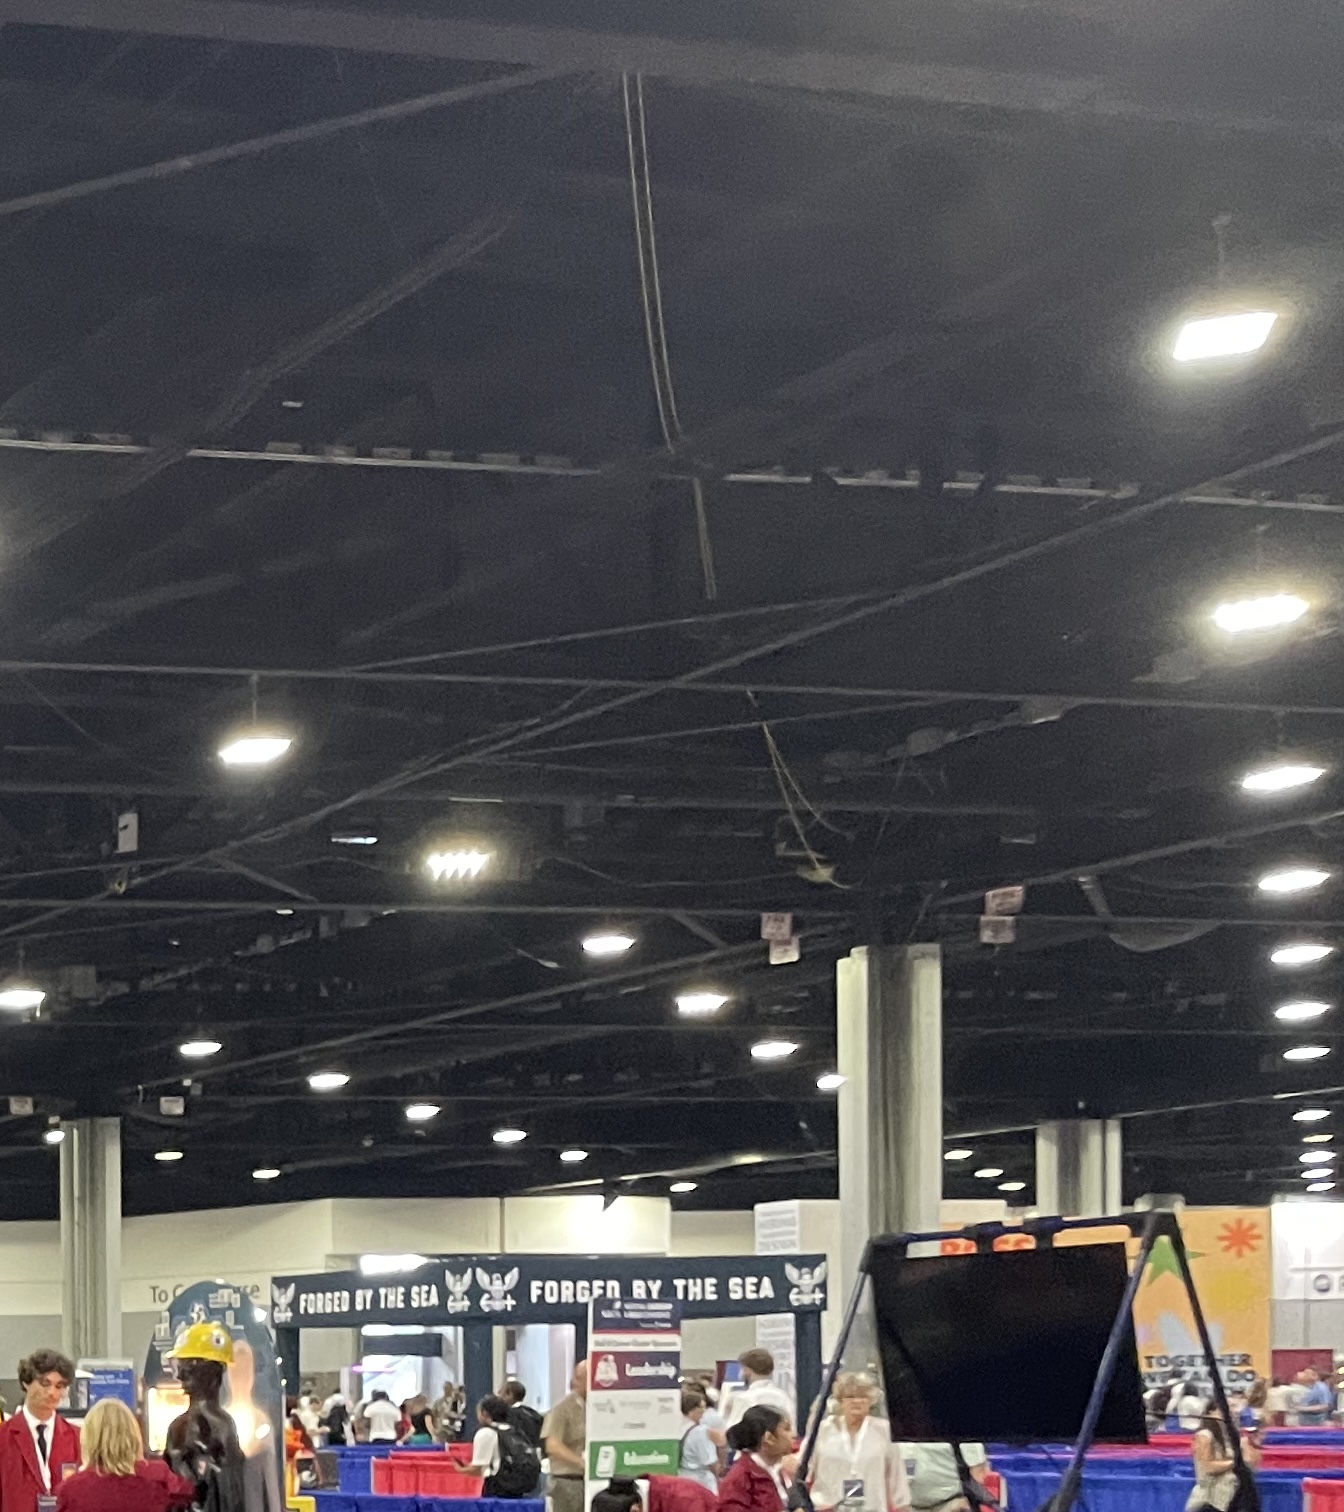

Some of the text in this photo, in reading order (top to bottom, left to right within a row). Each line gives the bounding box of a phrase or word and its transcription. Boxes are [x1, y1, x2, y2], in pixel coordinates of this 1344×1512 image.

[149, 1285, 169, 1304] To
[299, 1284, 440, 1315] FORGED BY THE SEA
[530, 1276, 775, 1304] FORGED BY THE SEA
